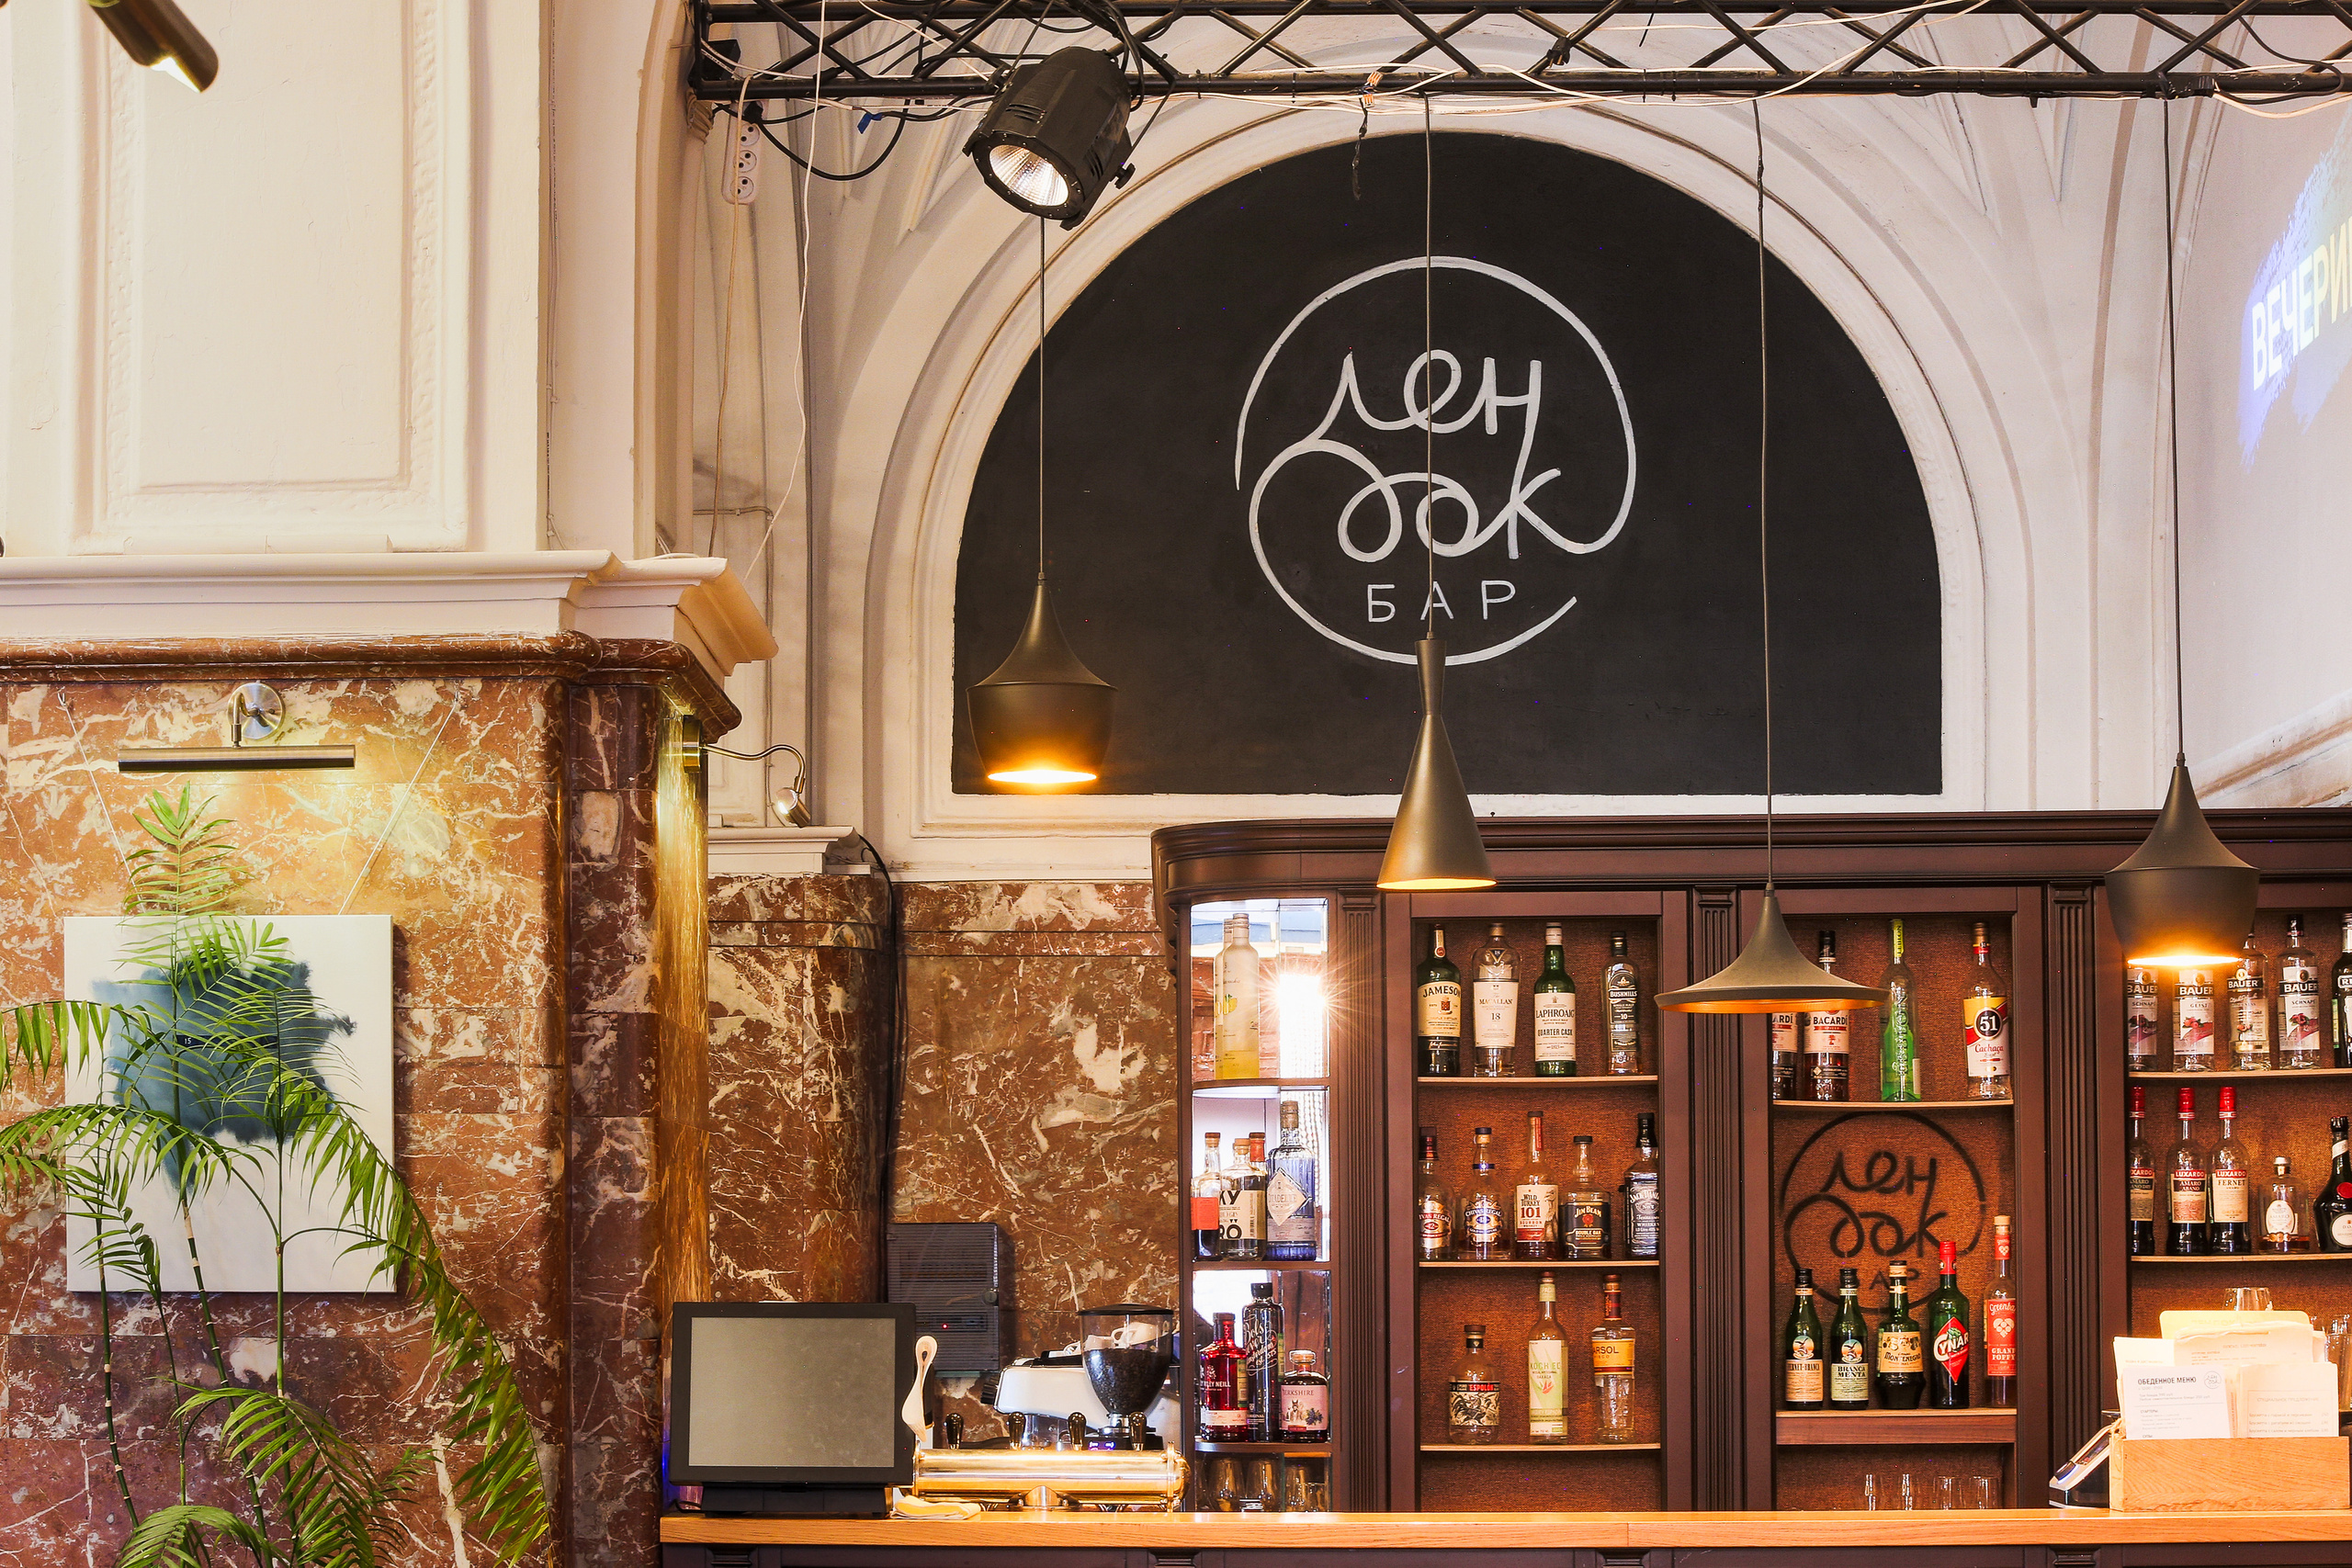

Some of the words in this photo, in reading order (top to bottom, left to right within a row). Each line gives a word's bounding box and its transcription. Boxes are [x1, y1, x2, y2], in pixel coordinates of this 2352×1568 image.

[2252, 215, 2352, 390] ВЕЧЕРИ
[1366, 580, 1516, 623] БАР
[2228, 979, 2258, 988] BAUER
[2179, 987, 2213, 996] BAUER
[1491, 1012, 1501, 1021] 18
[1535, 1009, 1575, 1019] LAPHROAIG
[1979, 1015, 1998, 1032] 51
[1561, 1028, 1573, 1036] CASK
[184, 1037, 192, 1045] 15
[1521, 1199, 1541, 1207] TURKEY
[1521, 1206, 1542, 1219] 101
[1574, 1207, 1586, 1219] JIM
[1586, 1205, 1602, 1218] BEAM
[1592, 1346, 1619, 1354] ARSOL
[1933, 1331, 1969, 1362] CYNAR
[2137, 1378, 2176, 1386] ОБЕДЕННОЕ
[2177, 1376, 2198, 1384] МЕНЮ
